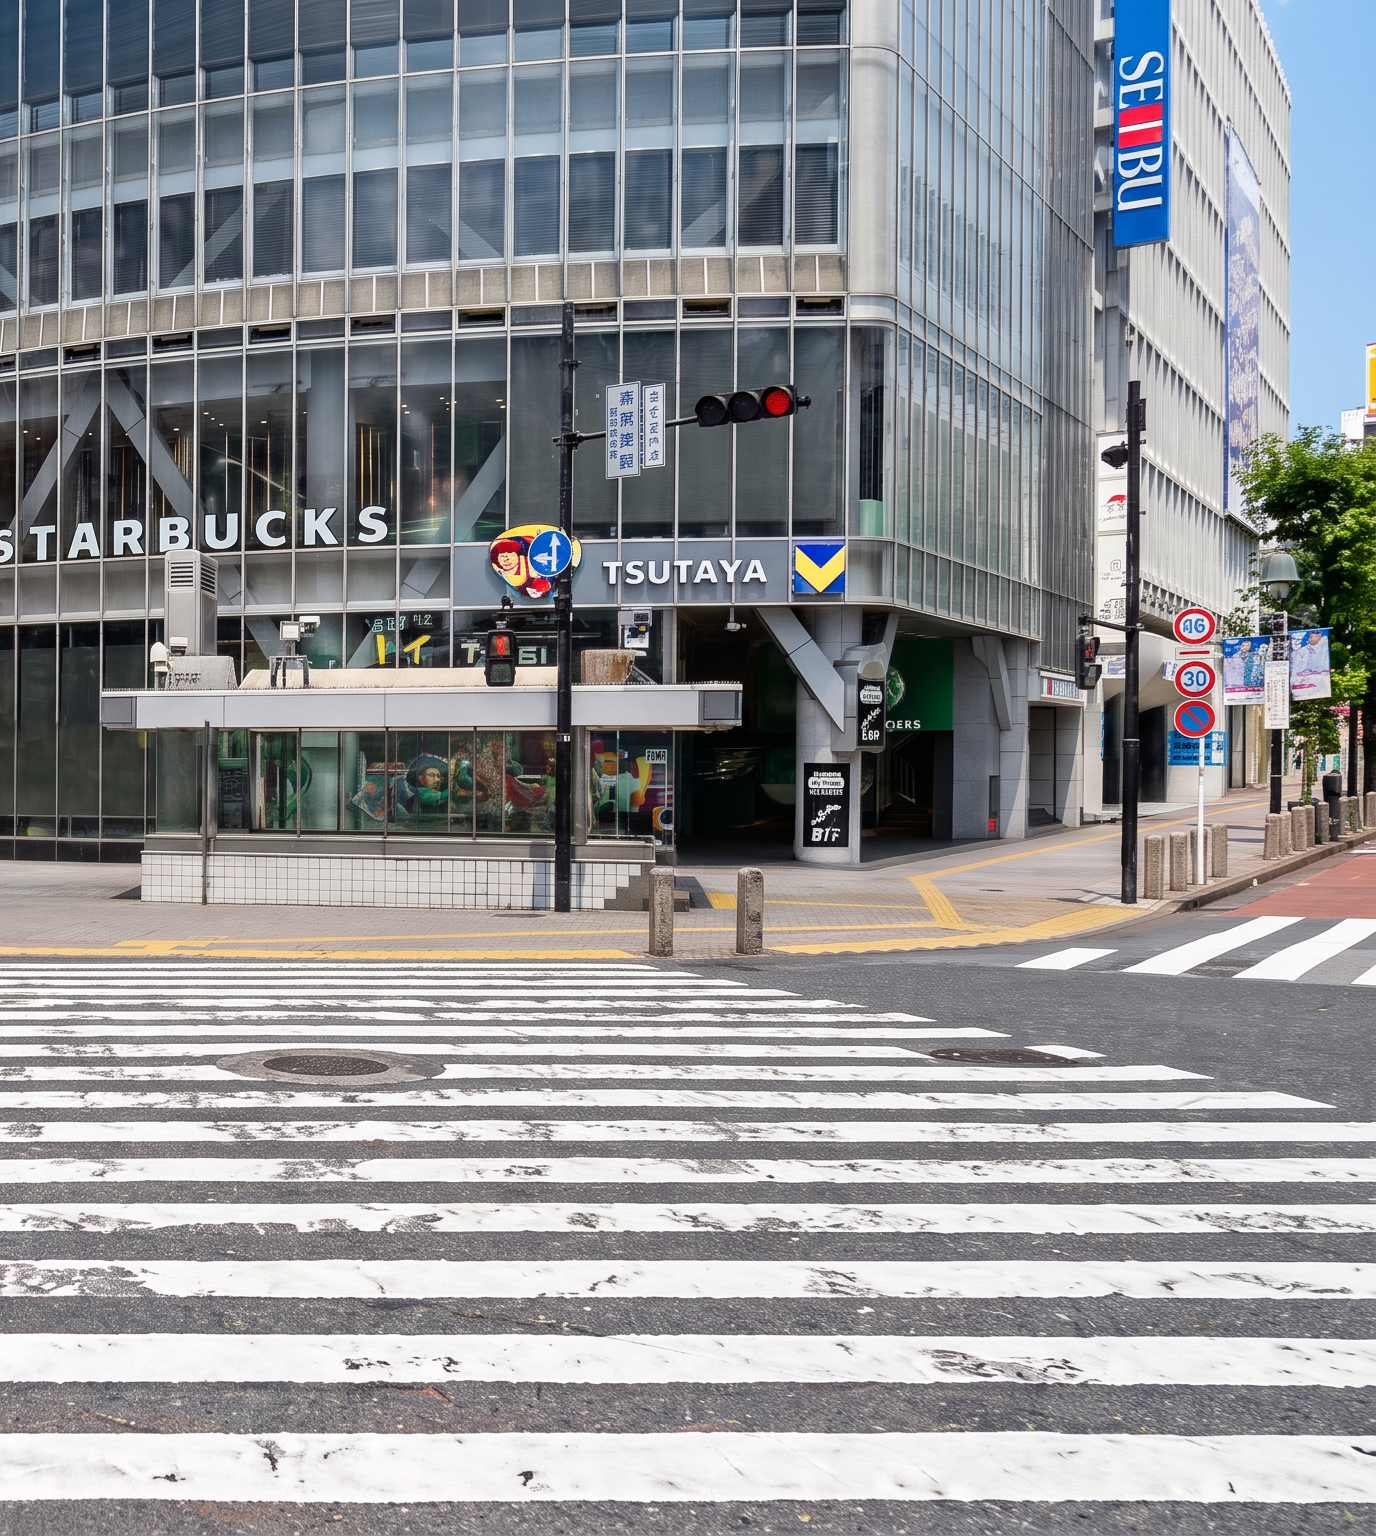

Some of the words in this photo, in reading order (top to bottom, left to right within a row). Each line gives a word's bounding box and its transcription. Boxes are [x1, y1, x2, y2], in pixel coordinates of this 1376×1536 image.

[1118, 51, 1164, 212] SEIBU
[602, 559, 768, 585] TSUTAYA
[1183, 670, 1207, 687] 30
